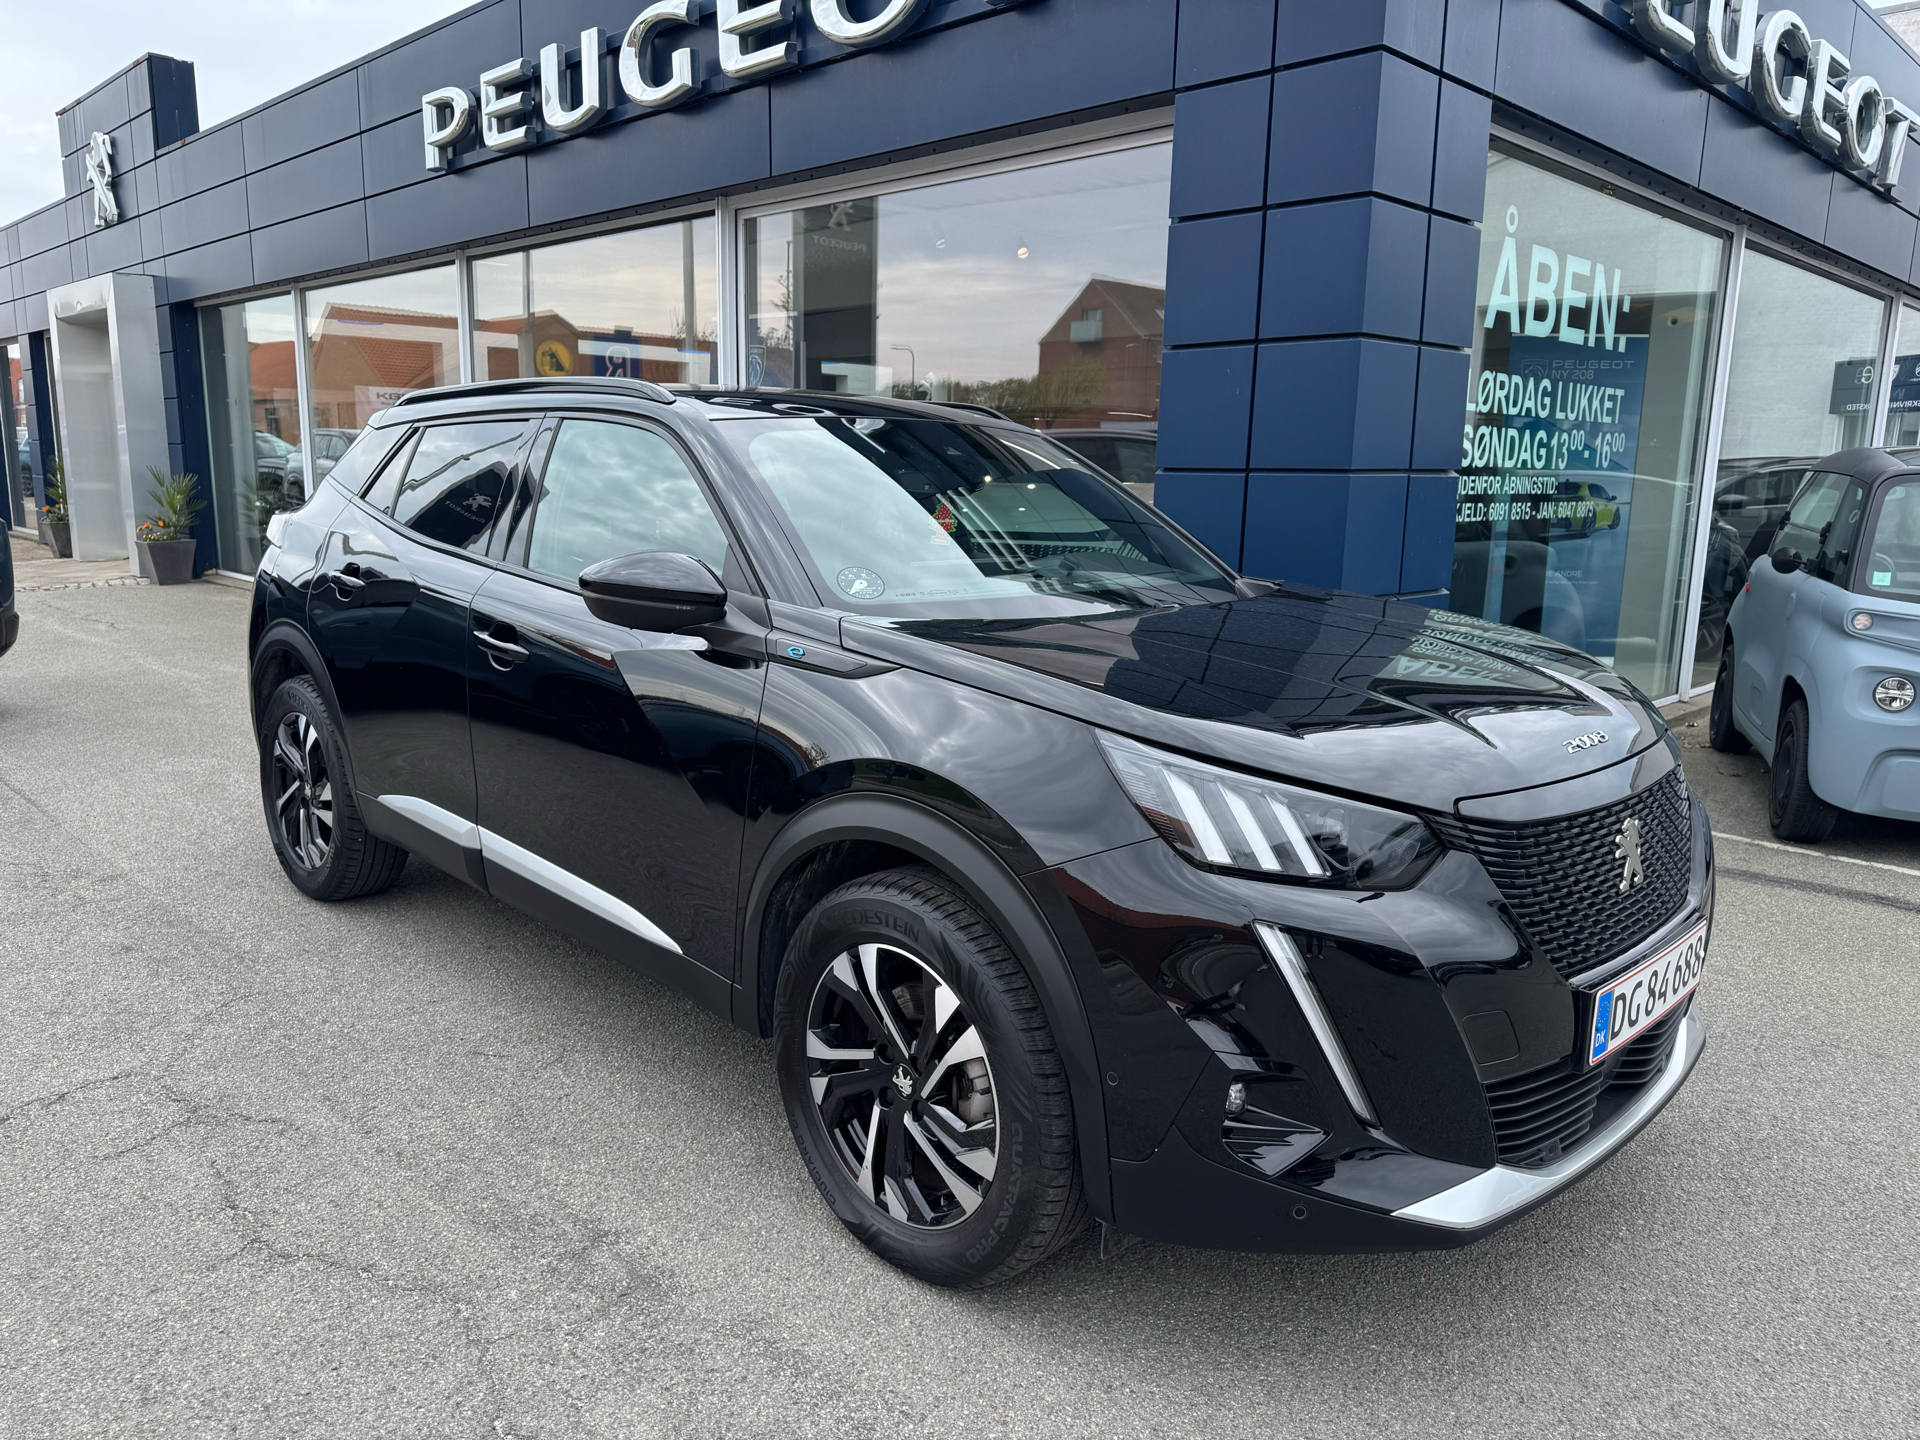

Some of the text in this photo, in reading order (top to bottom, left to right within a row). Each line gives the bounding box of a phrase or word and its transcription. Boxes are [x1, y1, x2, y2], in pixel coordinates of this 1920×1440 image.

[1483, 204, 1631, 353] ÅBEN:
[1551, 369, 1594, 380] NY 208
[1552, 360, 1635, 369] PEUGEOT
[1466, 368, 1625, 424] LØRDAG LUKKET
[1462, 424, 1548, 470] SØNDAG
[1503, 473, 1558, 495] ÅBNINGSTID:
[1489, 502, 1509, 520] 6091
[1510, 502, 1531, 520] 8515
[1537, 502, 1557, 519] JAN:
[1558, 501, 1576, 519] 6047
[1562, 730, 1609, 754] 2008
[1610, 934, 1703, 1042] DG 84 688
[1594, 1030, 1607, 1047] DK
